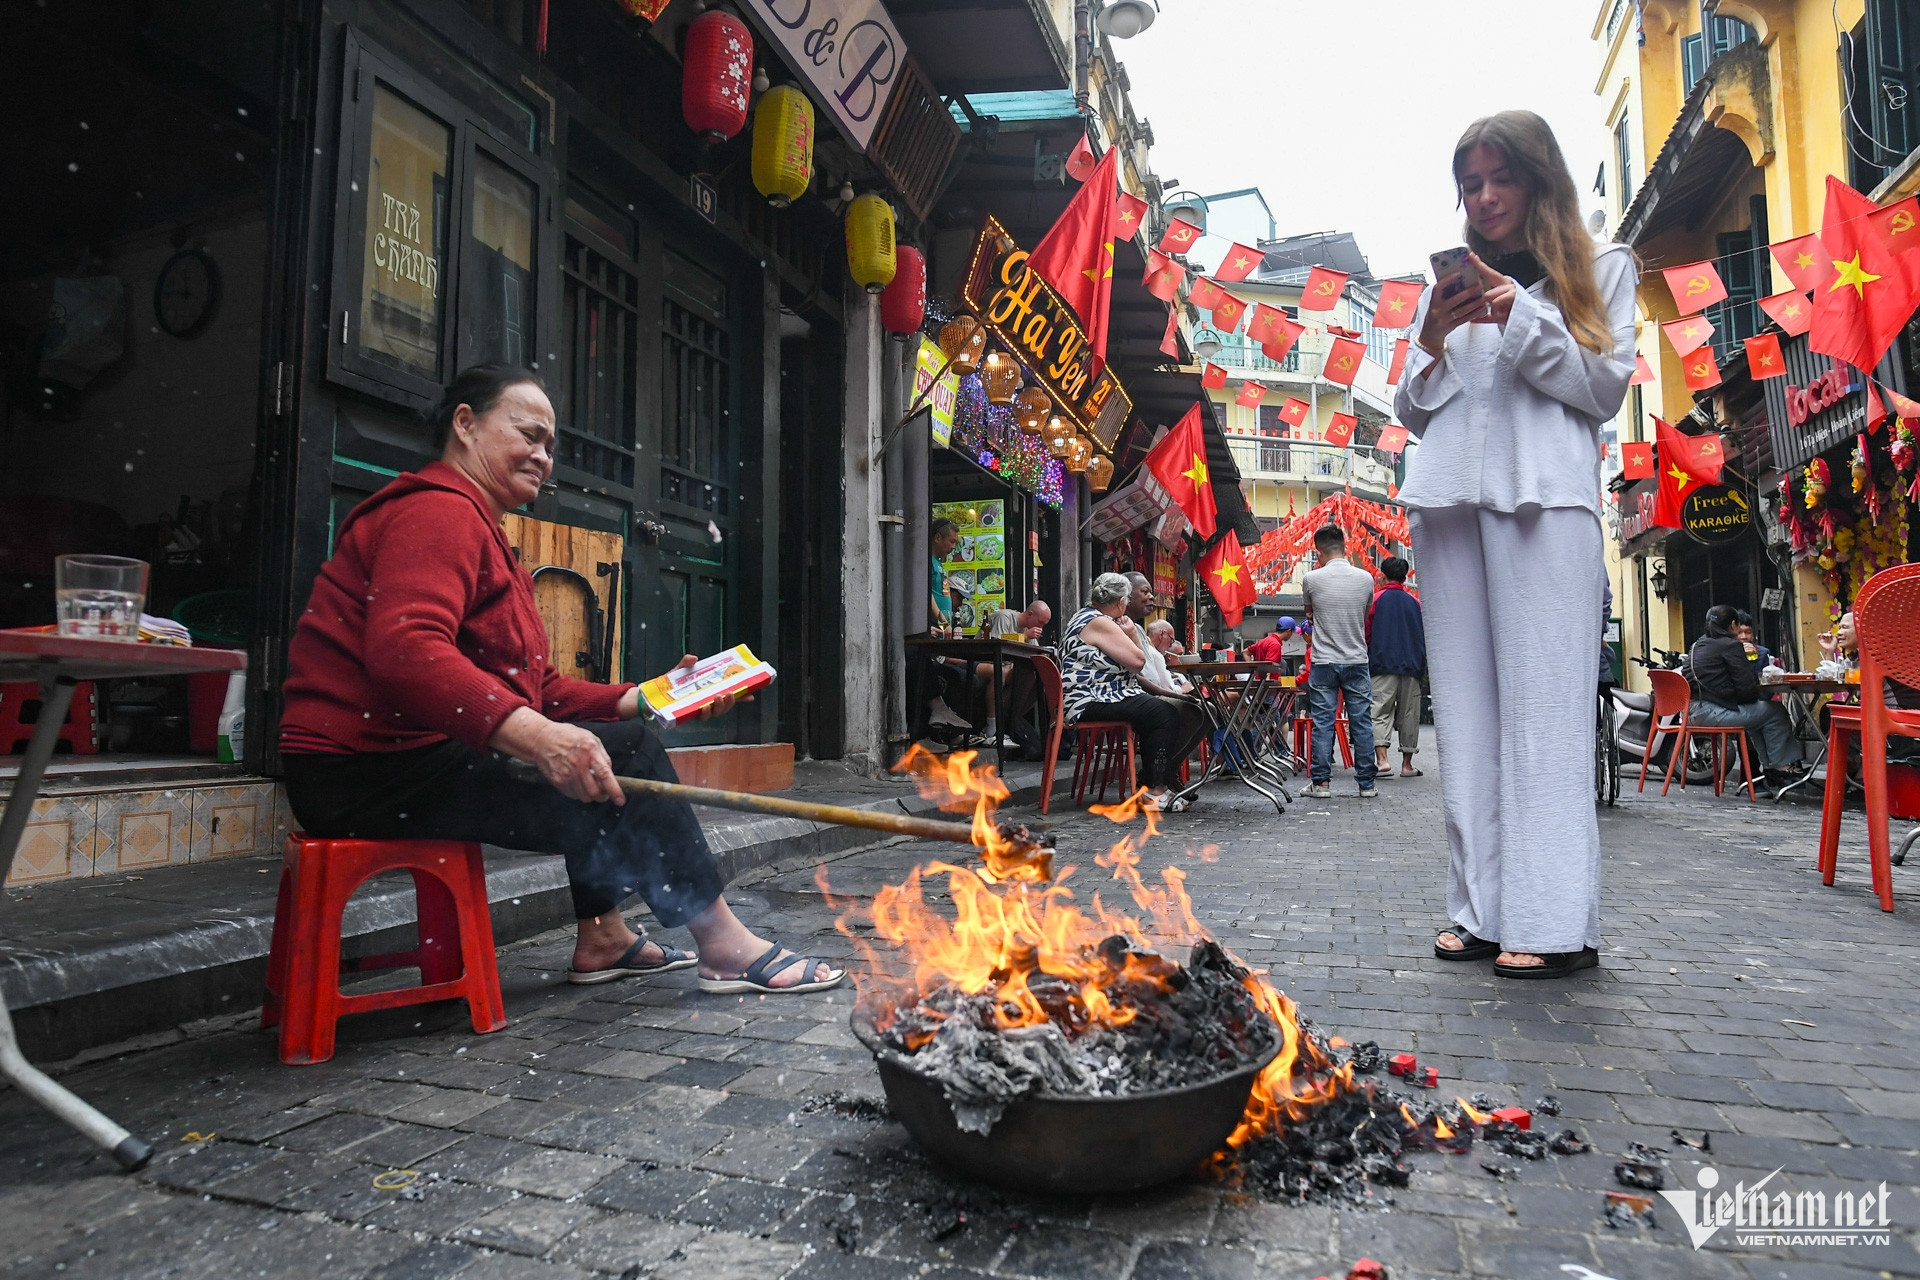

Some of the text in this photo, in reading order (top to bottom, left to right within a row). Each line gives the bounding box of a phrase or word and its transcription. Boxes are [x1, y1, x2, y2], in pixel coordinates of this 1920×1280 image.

[834, 20, 896, 122] B
[695, 183, 712, 214] 19
[1092, 379, 1112, 405] 21
[1693, 495, 1728, 512] Free
[1690, 513, 1749, 529] KARAOKE
